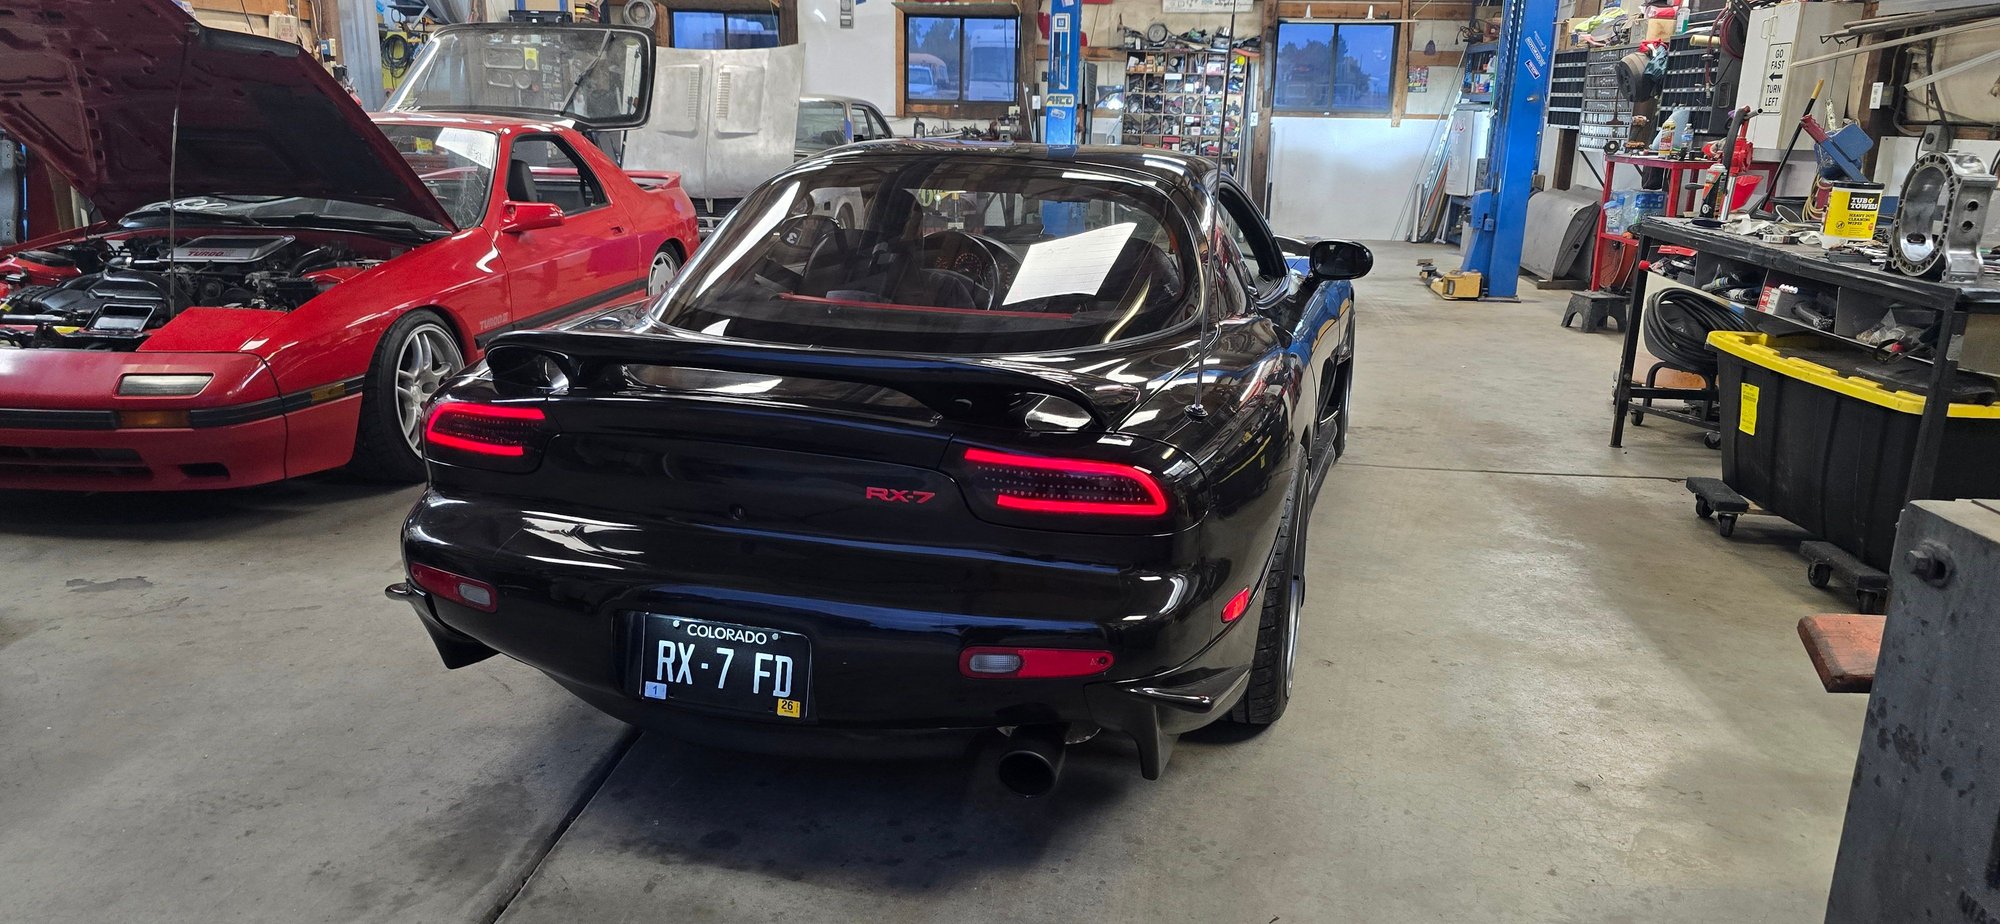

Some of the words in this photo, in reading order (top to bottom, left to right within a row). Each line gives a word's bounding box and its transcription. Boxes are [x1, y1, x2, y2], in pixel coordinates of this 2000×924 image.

[1775, 48, 1784, 58] GO
[1771, 60, 1785, 70] FAST
[1766, 84, 1781, 94] TURN
[1765, 97, 1778, 107] LEFT
[866, 486, 936, 504] RX-7
[686, 624, 767, 645] COLORADO
[753, 652, 794, 698] FD
[652, 686, 659, 696] 1
[781, 700, 794, 711] 26
